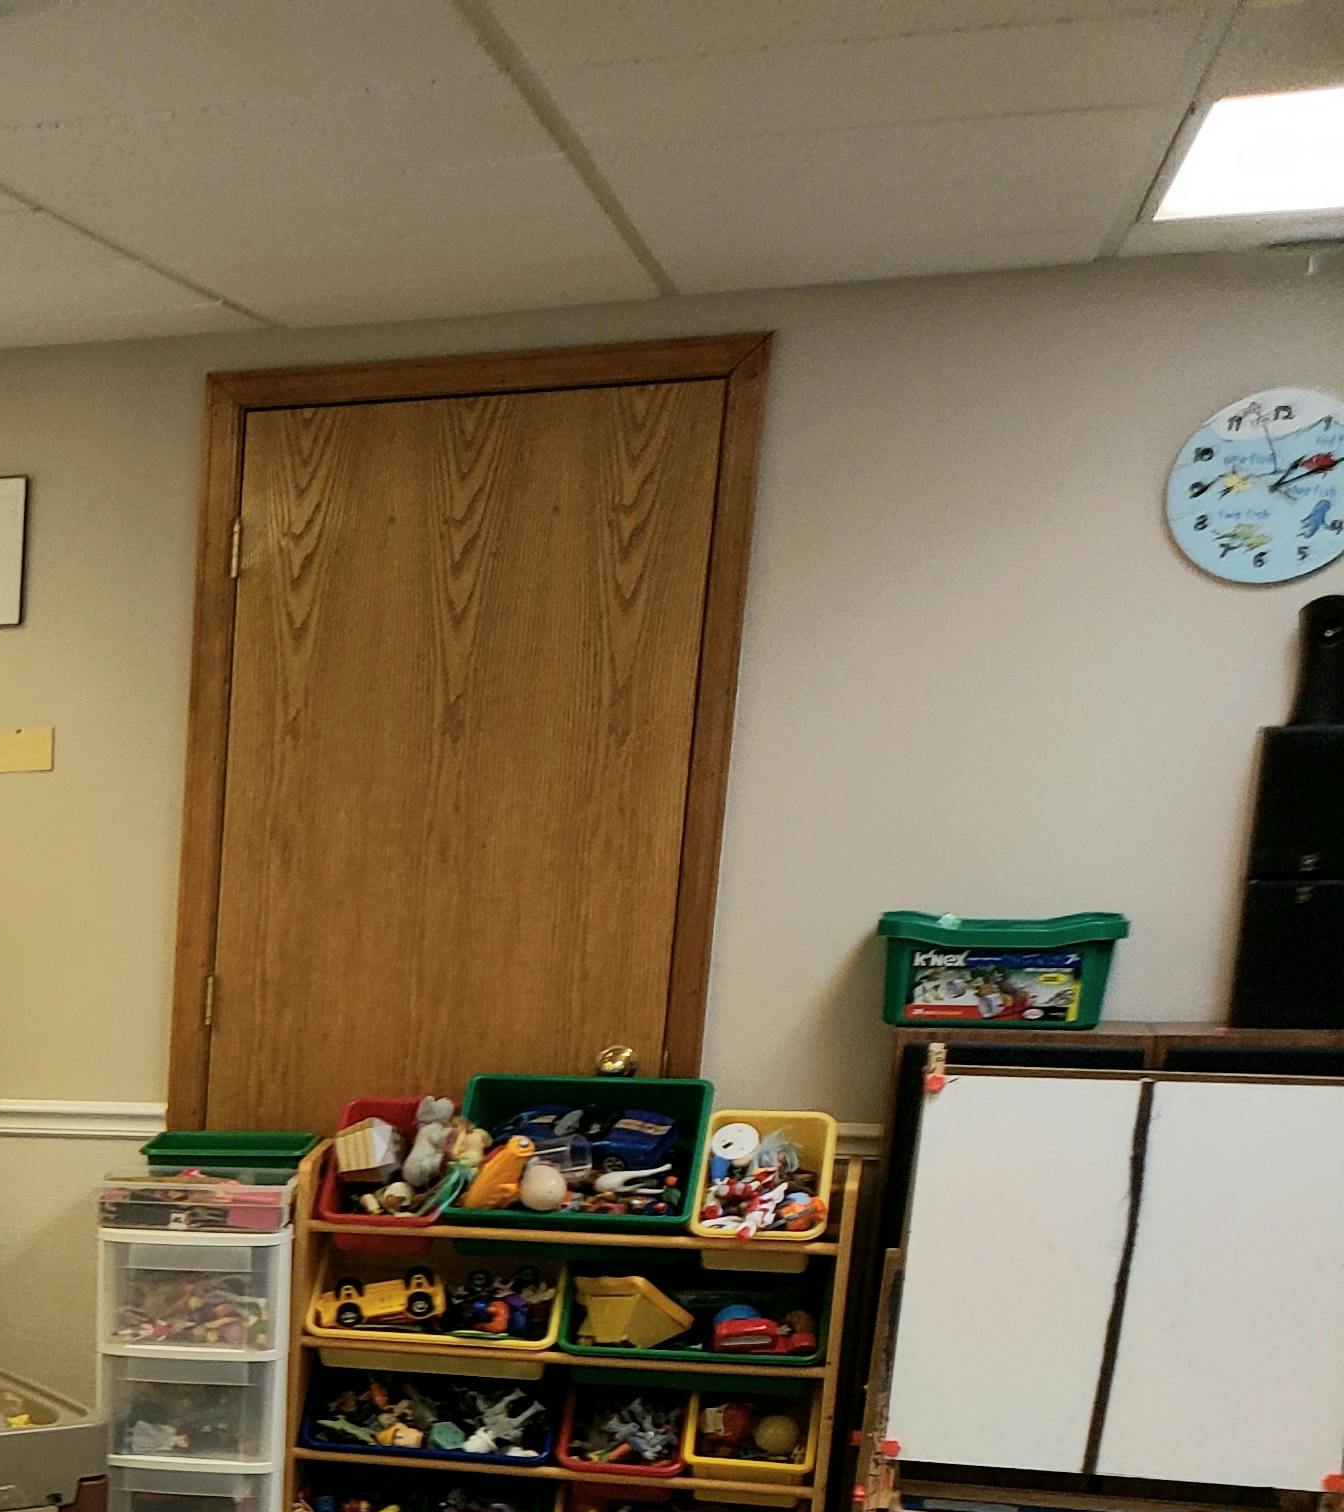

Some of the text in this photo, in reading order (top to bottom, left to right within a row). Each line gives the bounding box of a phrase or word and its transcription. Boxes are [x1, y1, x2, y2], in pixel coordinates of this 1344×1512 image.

[1193, 513, 1209, 531] 8
[1253, 551, 1269, 568] 6
[1296, 546, 1310, 561] 5
